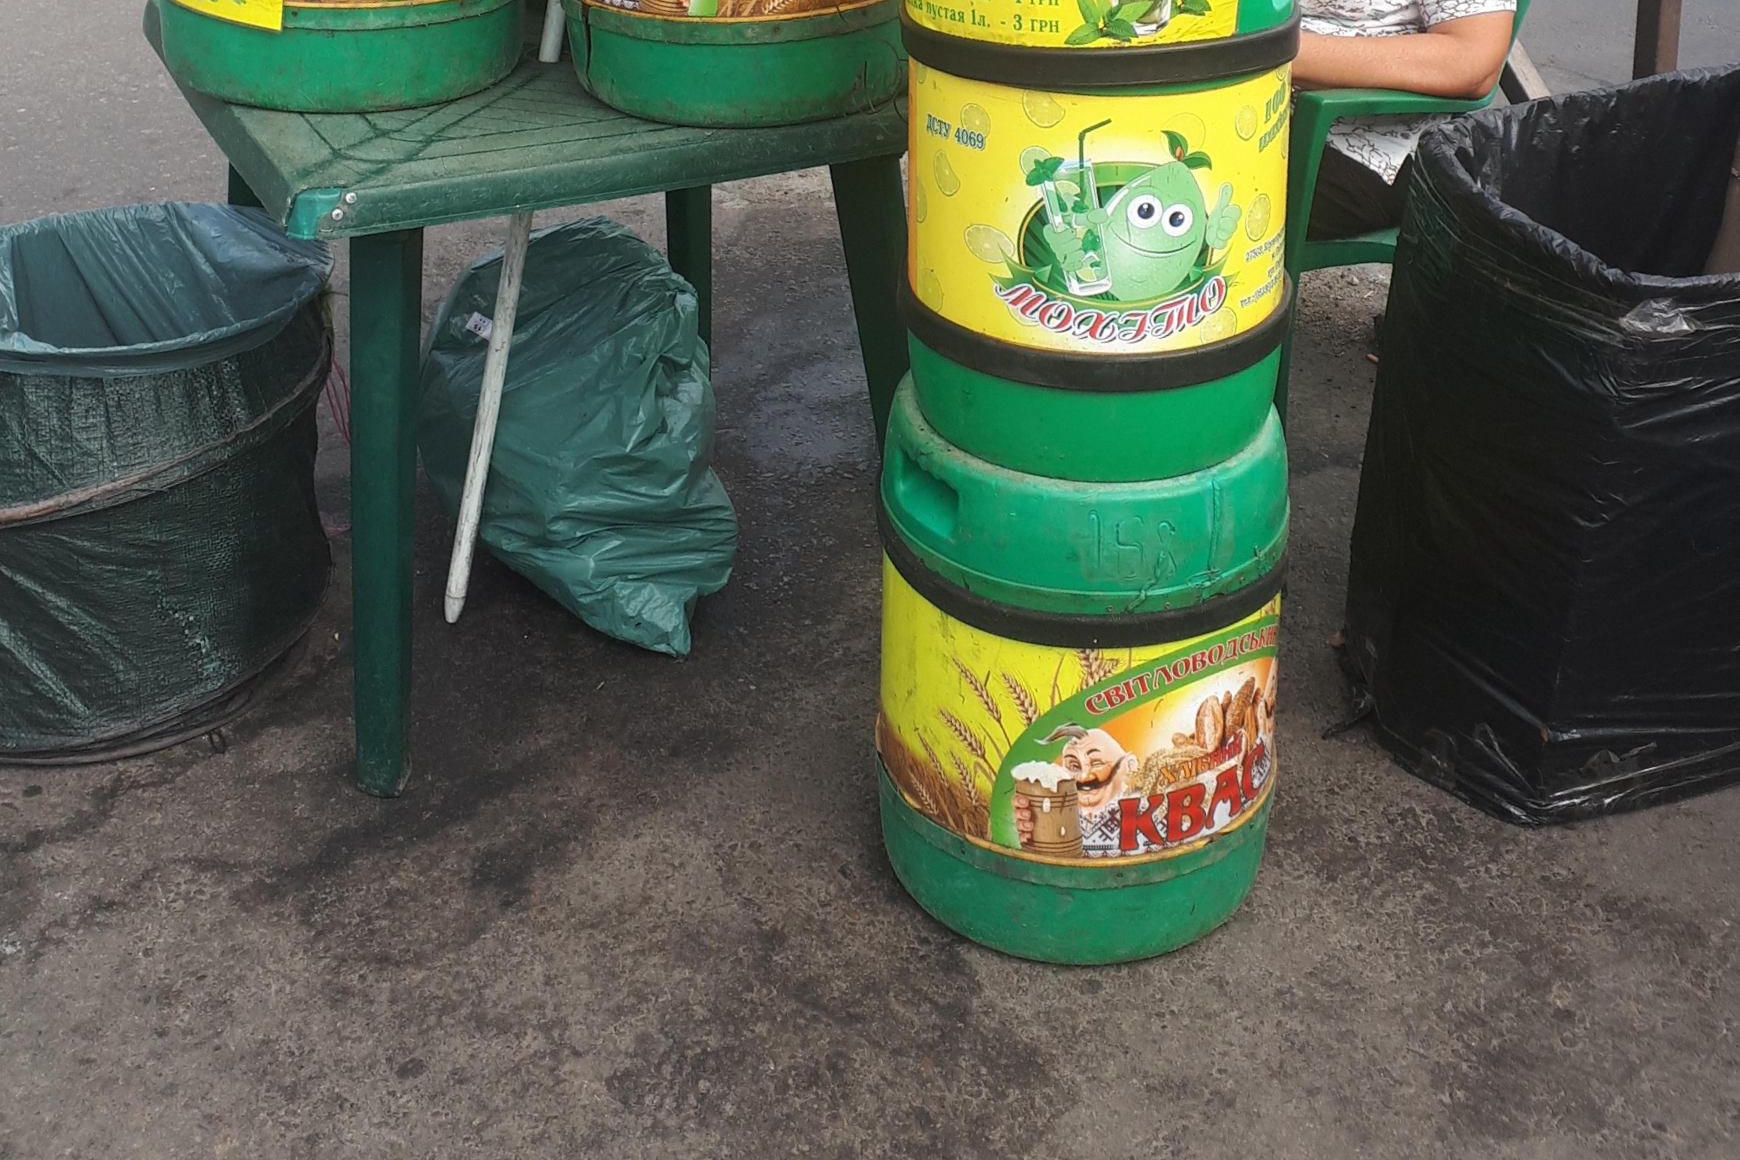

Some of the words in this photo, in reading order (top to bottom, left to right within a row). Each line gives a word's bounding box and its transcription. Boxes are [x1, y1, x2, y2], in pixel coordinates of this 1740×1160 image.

[925, 3, 966, 24] пустая
[1013, 14, 1024, 31] 3
[1030, 18, 1061, 34] ГРН
[926, 113, 952, 139] ДСТУ
[954, 127, 986, 151] 4069
[1118, 740, 1266, 851] КВАС
